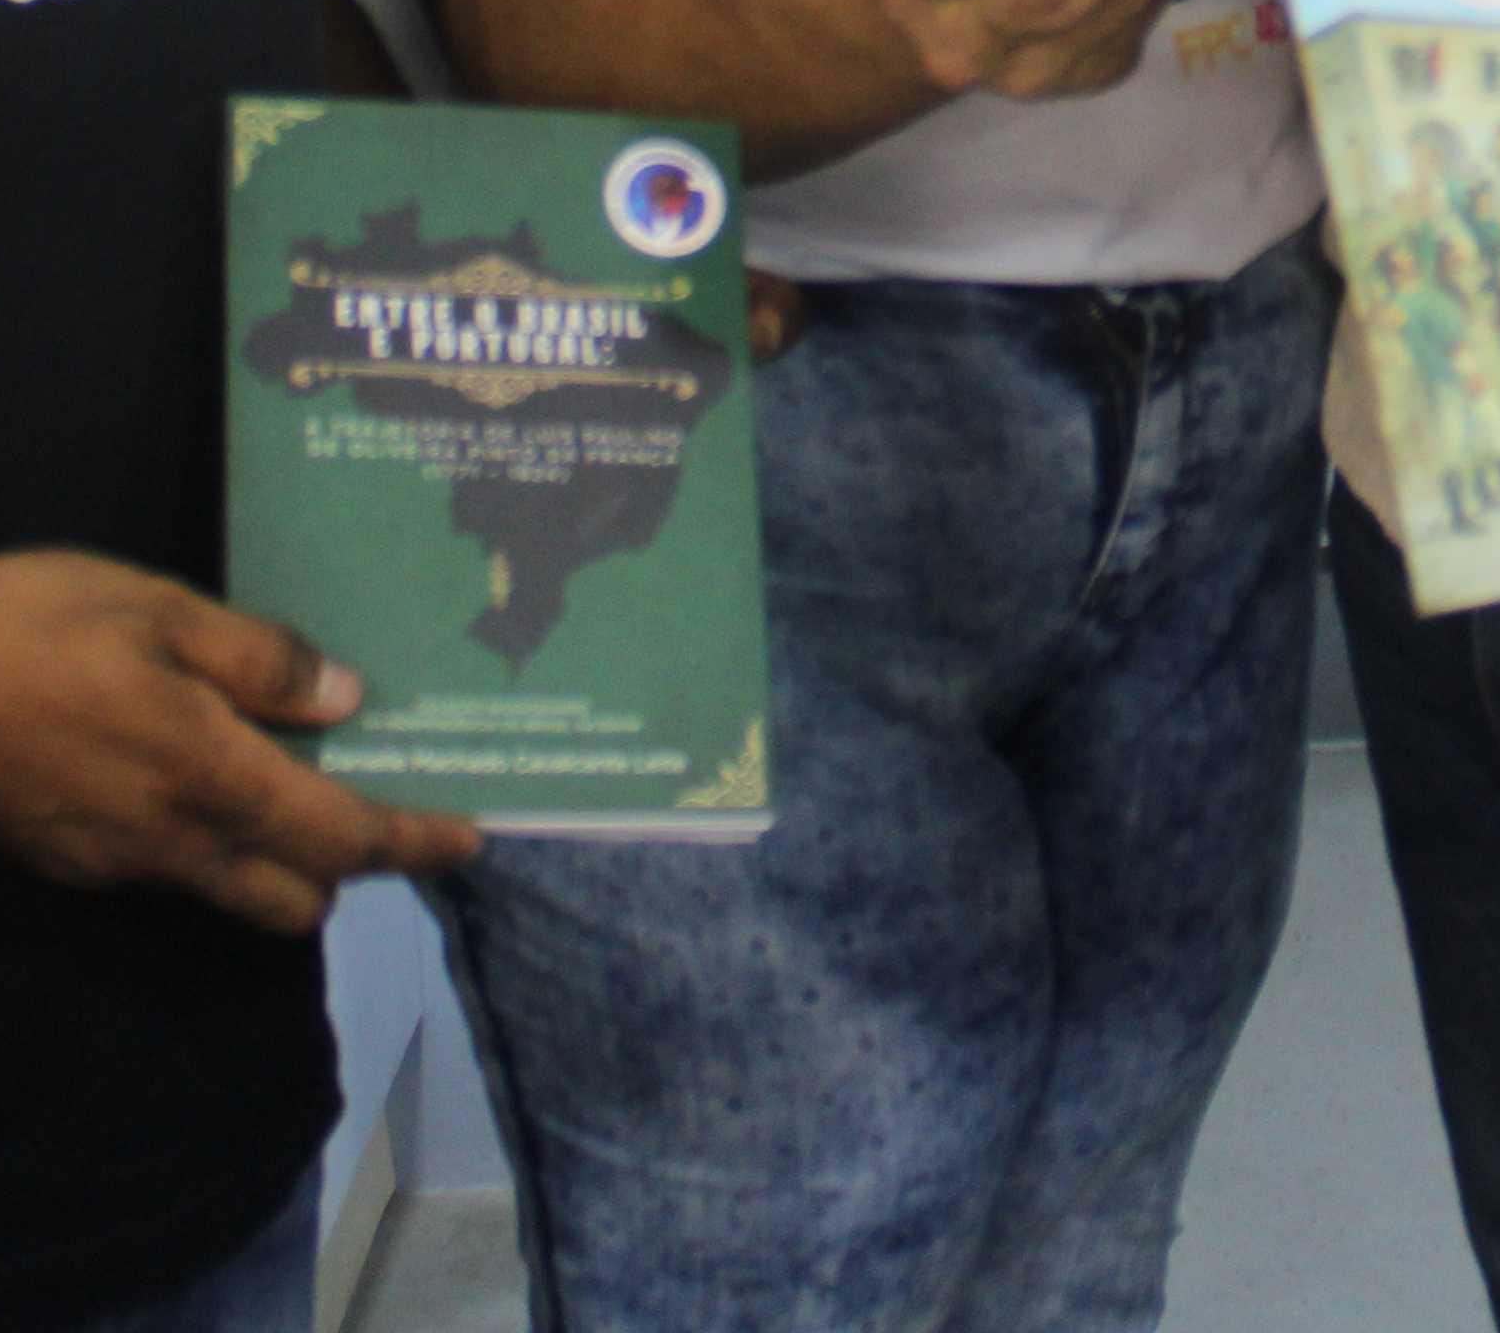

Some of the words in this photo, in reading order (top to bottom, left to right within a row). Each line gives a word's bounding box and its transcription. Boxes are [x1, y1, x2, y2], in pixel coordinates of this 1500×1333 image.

[334, 290, 455, 332] ENTRE
[517, 298, 648, 339] BRASIL
[369, 327, 391, 359] E
